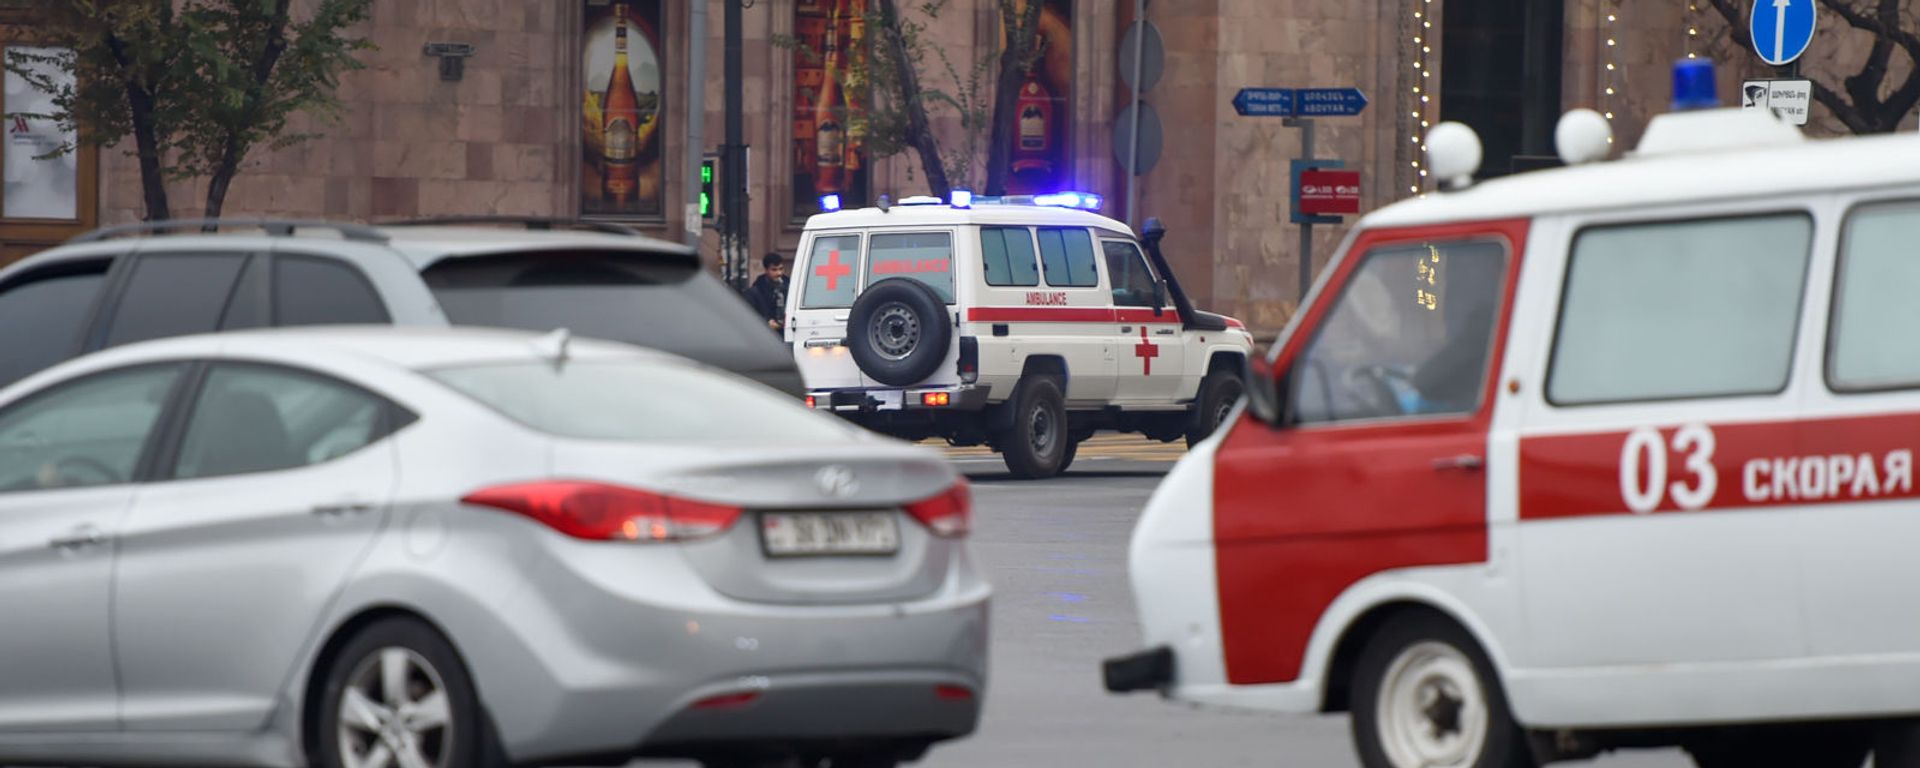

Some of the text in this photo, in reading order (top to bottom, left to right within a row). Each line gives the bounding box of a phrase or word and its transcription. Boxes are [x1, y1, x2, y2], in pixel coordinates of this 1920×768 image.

[872, 257, 949, 274] AMBULANCE
[1025, 291, 1067, 306] AMBULANCE
[1619, 423, 1913, 514] 03 СКОРАЯ
